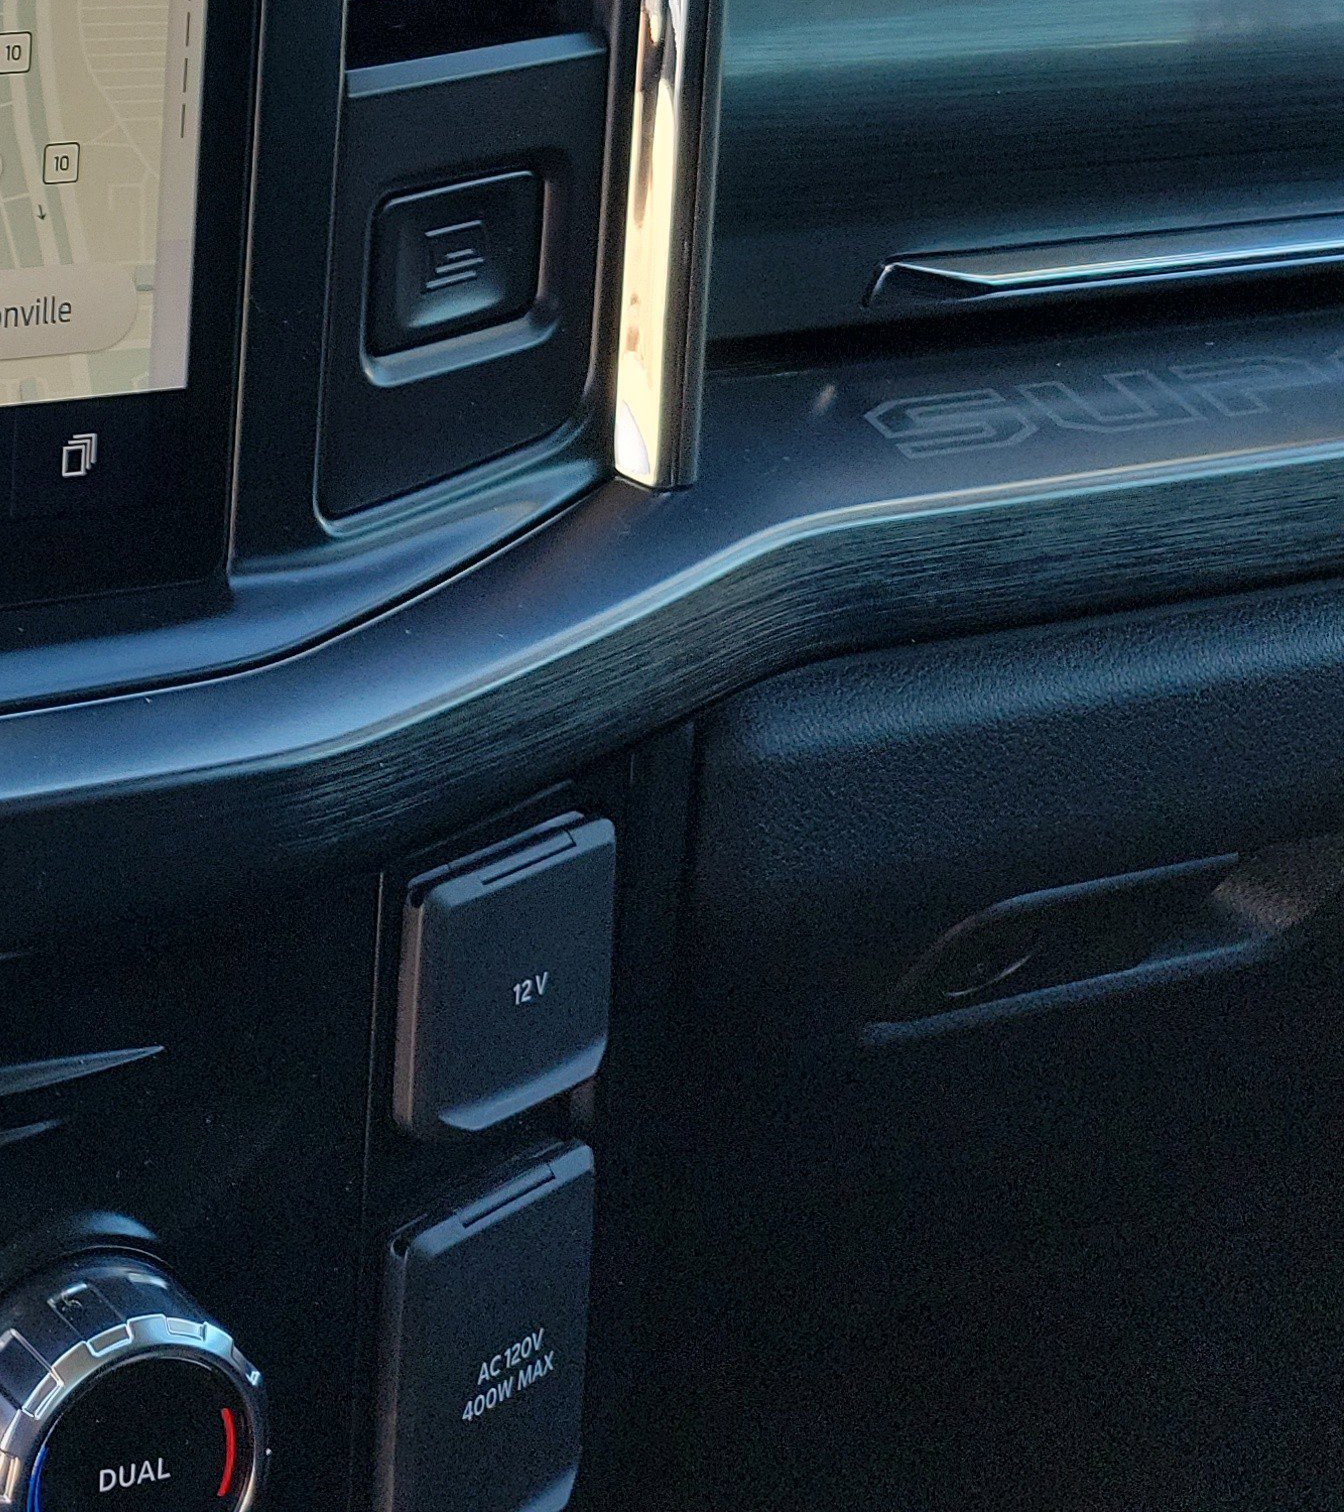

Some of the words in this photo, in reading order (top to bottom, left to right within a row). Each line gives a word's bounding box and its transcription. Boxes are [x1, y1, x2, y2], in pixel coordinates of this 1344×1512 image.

[5, 43, 22, 61] 10
[53, 154, 70, 172] 10
[862, 353, 1344, 460] SUP
[477, 1357, 502, 1386] AC
[503, 1326, 545, 1372] 120V
[461, 1380, 515, 1424] 400W
[517, 1349, 555, 1393] MAX
[97, 1455, 172, 1493] DUAL
